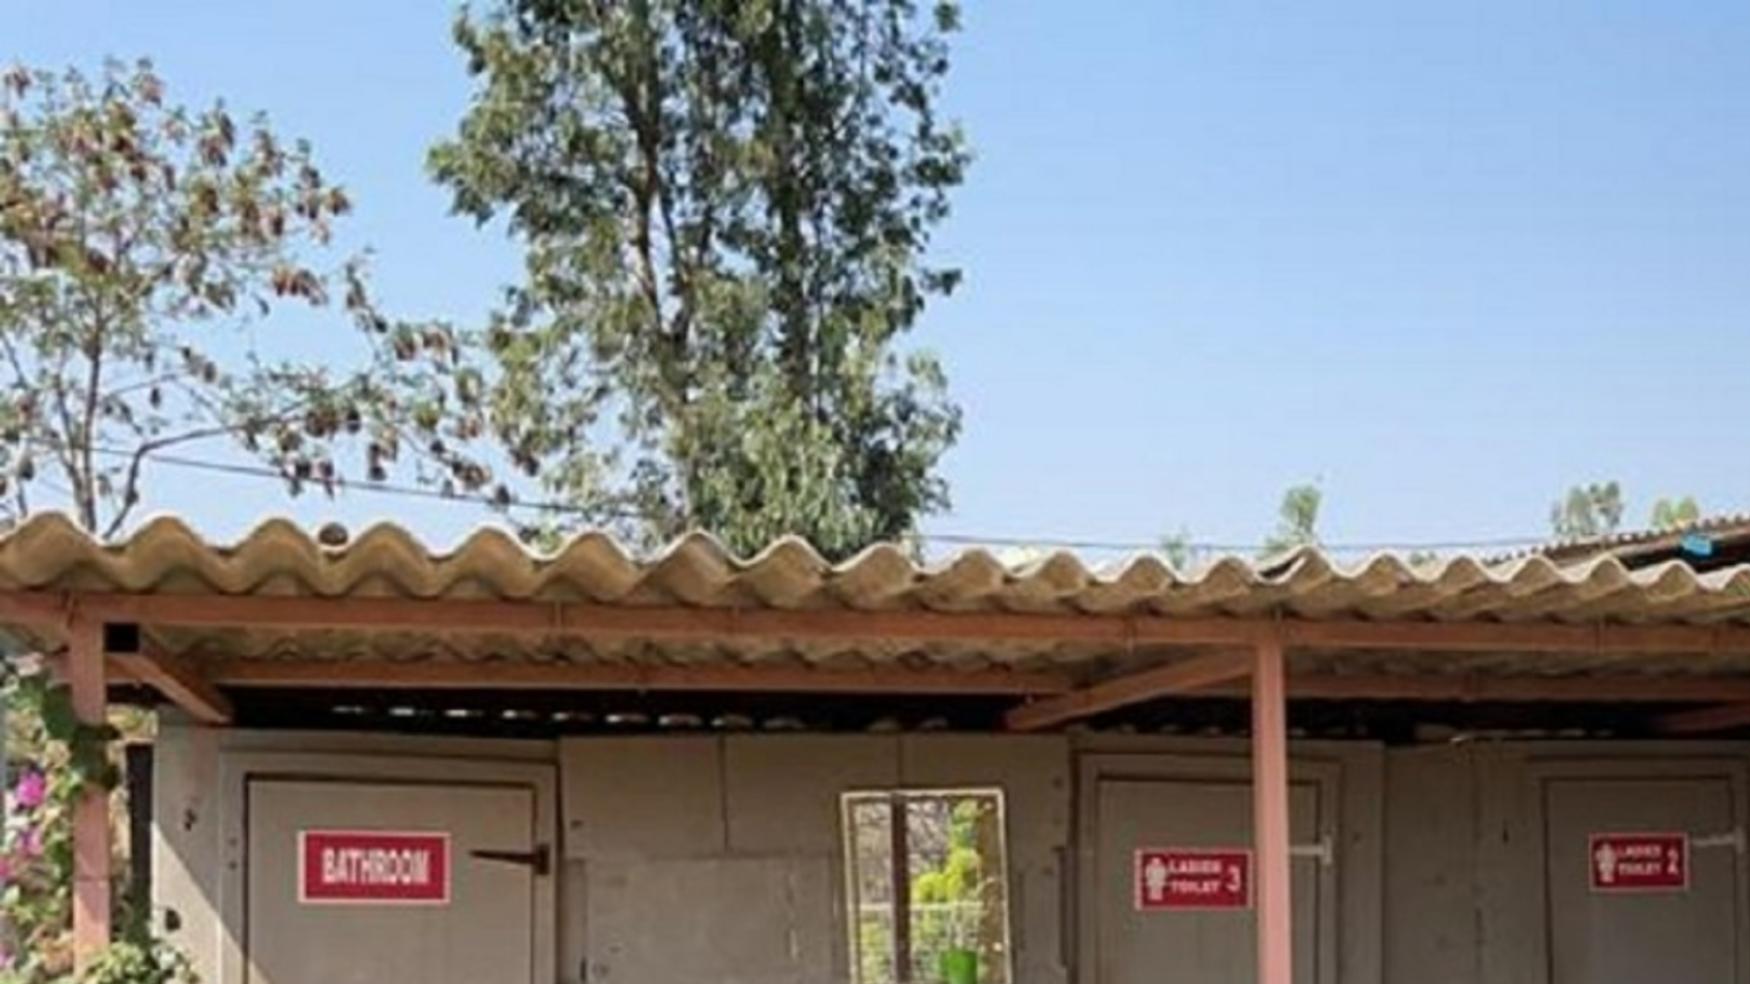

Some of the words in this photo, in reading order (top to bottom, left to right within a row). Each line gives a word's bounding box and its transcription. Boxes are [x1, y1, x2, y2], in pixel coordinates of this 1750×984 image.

[322, 849, 429, 883] BATHROOM
[1168, 859, 1221, 874] LADIES
[1618, 862, 1661, 875] TOILET
[1226, 864, 1241, 892] 3
[1171, 880, 1221, 893] TOILET
